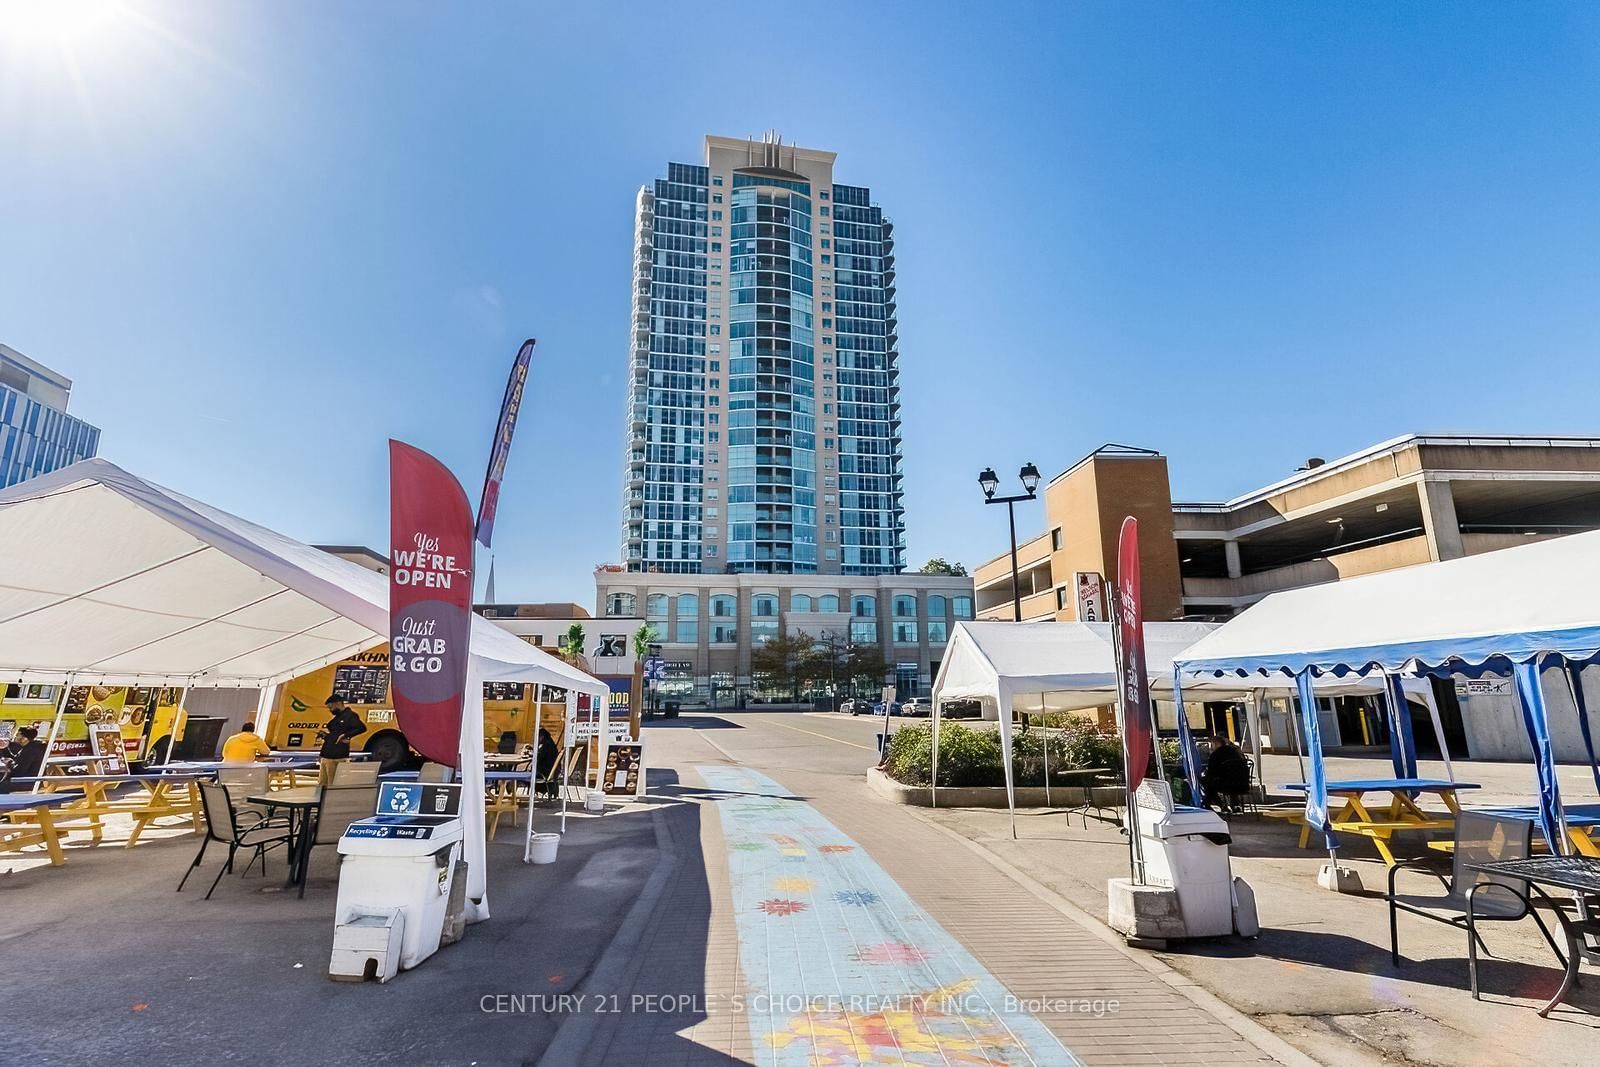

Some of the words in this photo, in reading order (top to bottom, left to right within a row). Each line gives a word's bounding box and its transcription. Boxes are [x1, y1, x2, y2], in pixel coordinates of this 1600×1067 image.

[413, 532, 439, 554] Yes
[394, 549, 456, 571] WE'RE
[395, 568, 452, 589] OPEN
[402, 616, 436, 638] Just
[392, 636, 446, 655] GRAB
[394, 655, 407, 672] &
[410, 656, 443, 673] GO
[348, 828, 377, 836] Recycling
